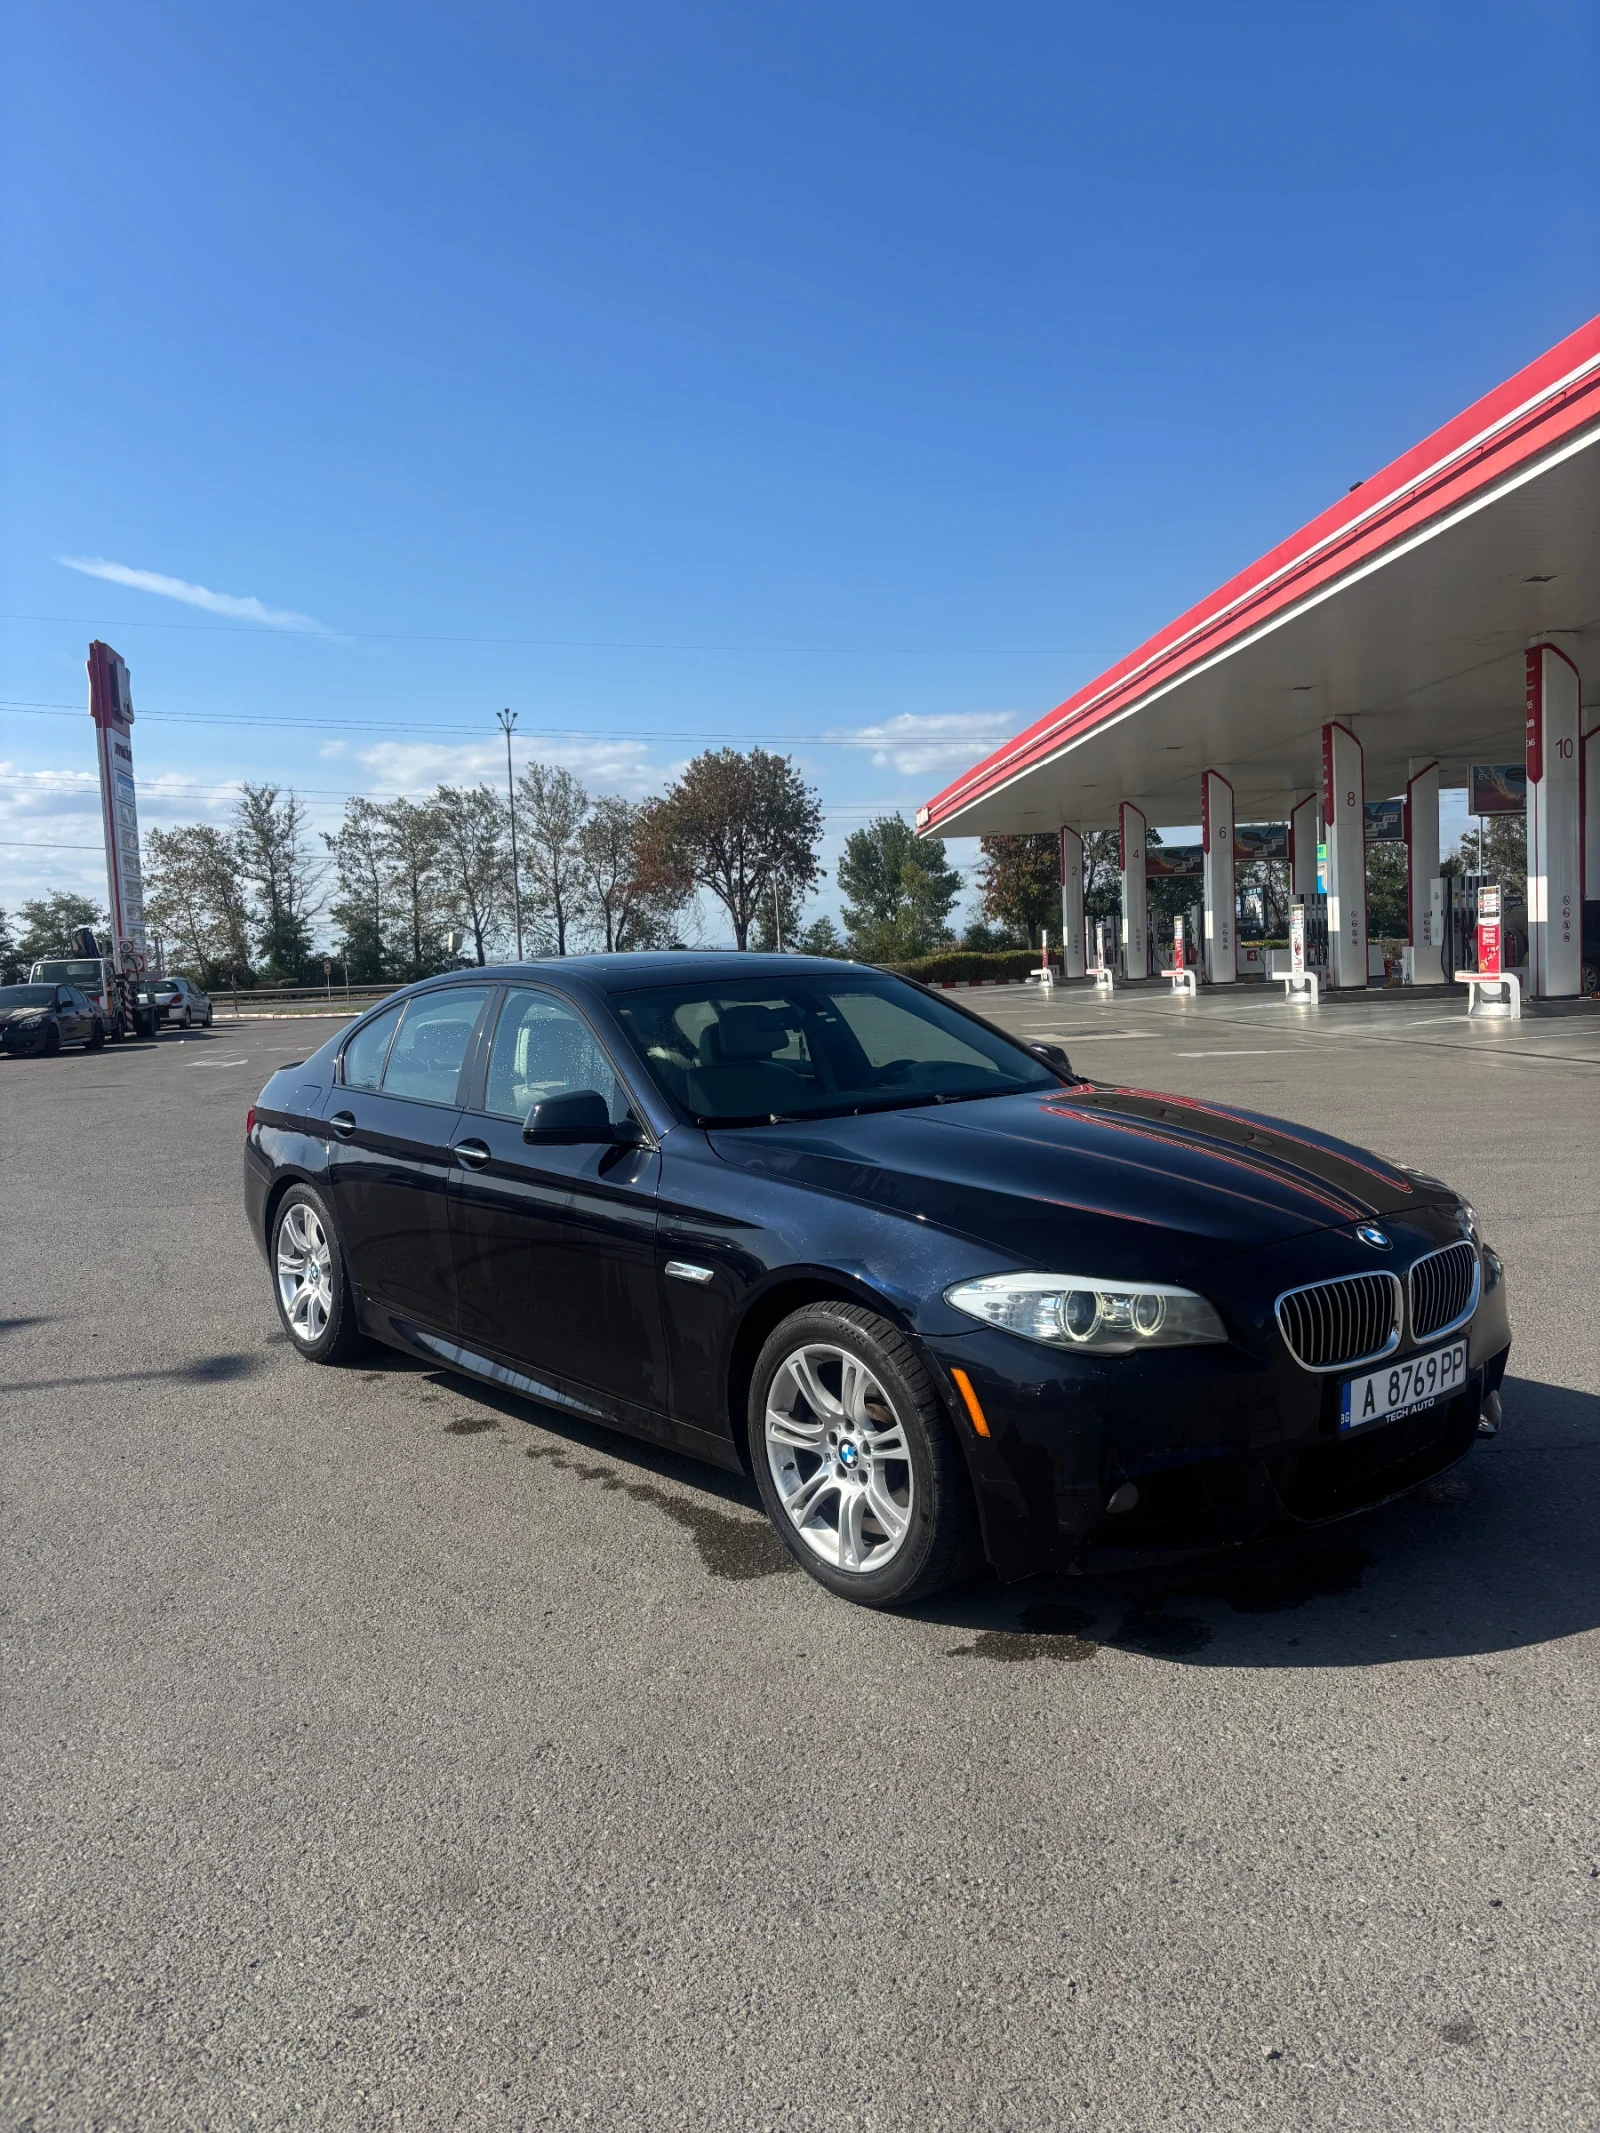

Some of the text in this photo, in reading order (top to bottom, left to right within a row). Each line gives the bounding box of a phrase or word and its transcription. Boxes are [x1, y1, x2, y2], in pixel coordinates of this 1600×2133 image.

[1555, 738, 1573, 759] 10
[1347, 791, 1356, 807] 8
[1219, 826, 1227, 839] 6
[1132, 849, 1140, 860] 4
[1071, 866, 1078, 876] 2
[1362, 1379, 1376, 1418] A
[1385, 1397, 1435, 1423] TECH AUTO
